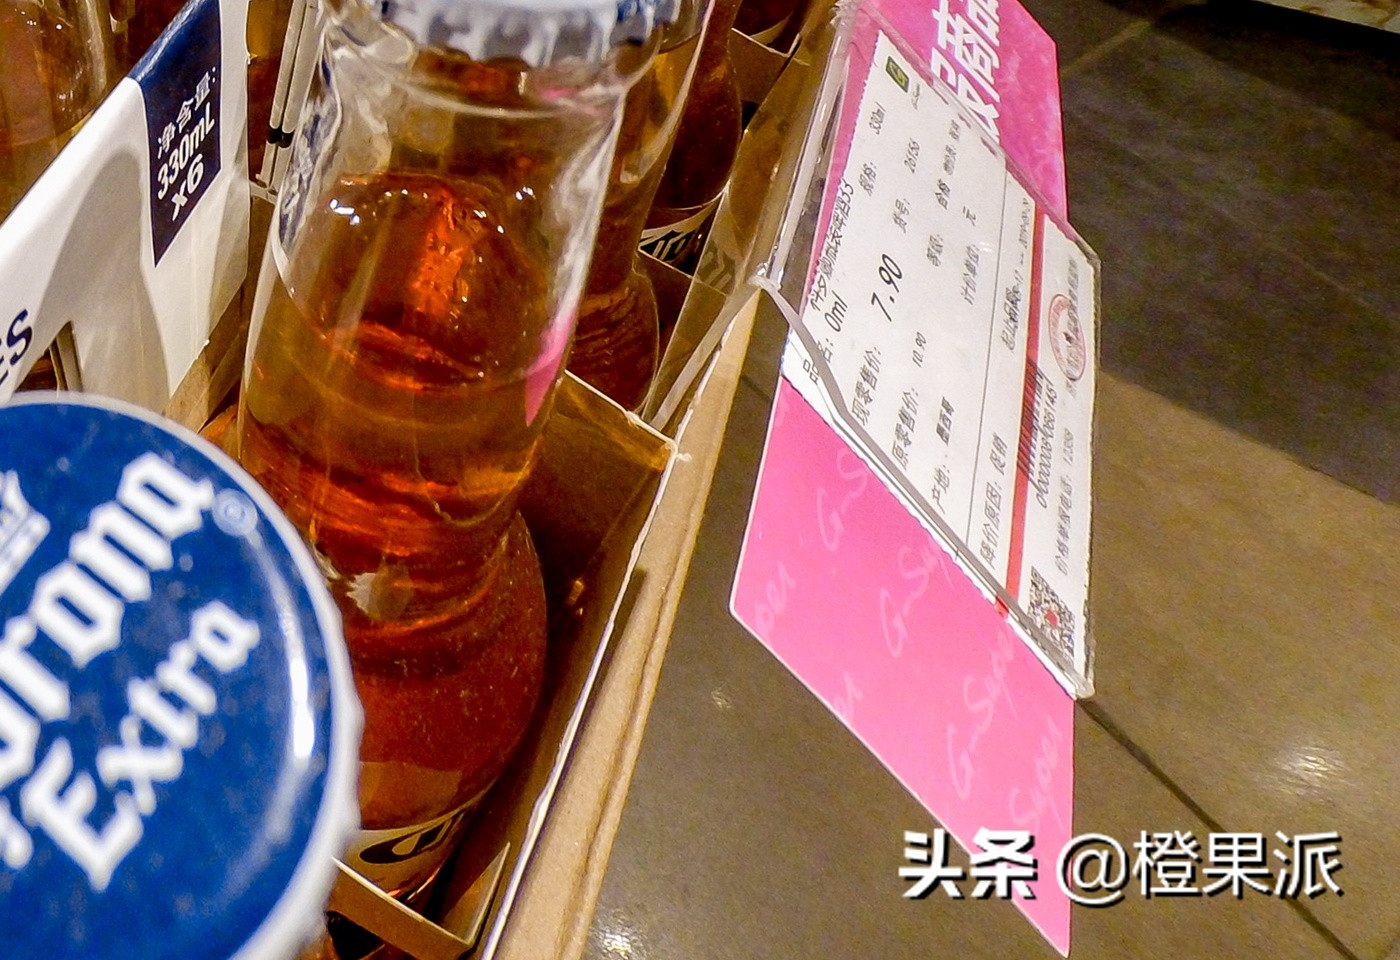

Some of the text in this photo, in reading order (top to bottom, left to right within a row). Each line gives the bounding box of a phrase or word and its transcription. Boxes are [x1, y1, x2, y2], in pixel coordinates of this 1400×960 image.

[157, 102, 216, 201] 330mL
[870, 247, 903, 328] 7.90
[19, 605, 261, 890] Extra
